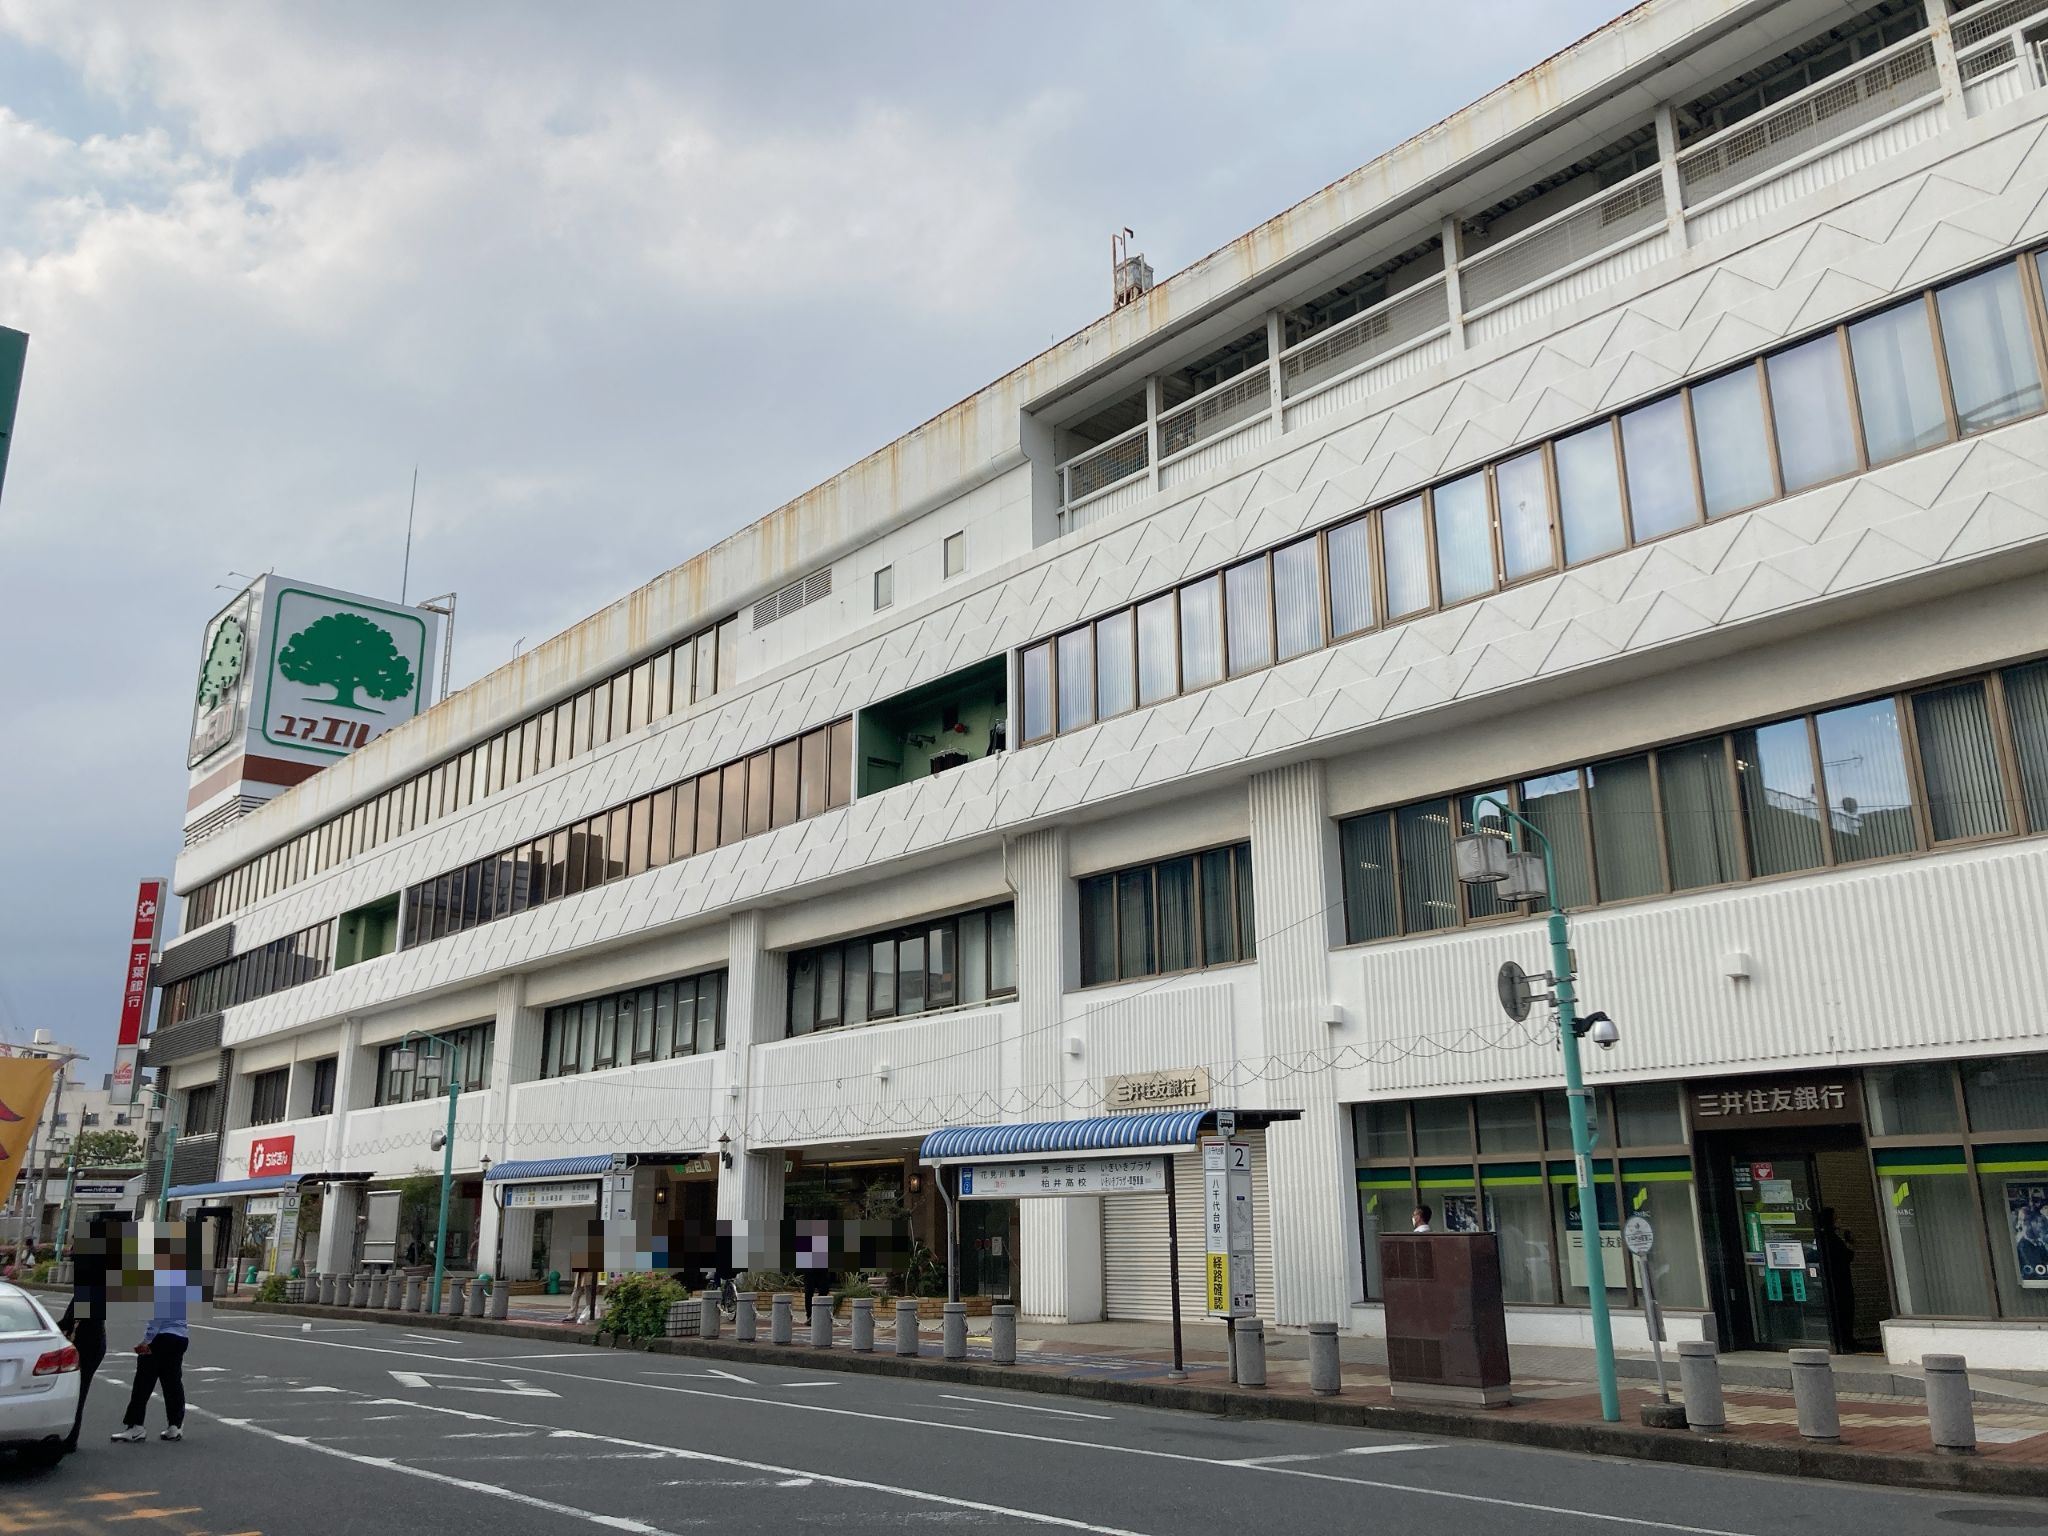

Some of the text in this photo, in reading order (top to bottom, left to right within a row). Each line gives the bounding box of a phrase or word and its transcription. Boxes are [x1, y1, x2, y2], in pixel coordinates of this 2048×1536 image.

[127, 952, 147, 1008] 千葉銀行
[1117, 1078, 1196, 1102] 三井住友銀行
[1698, 1084, 1845, 1116] 三井住友銀行
[1101, 1161, 1152, 1173] いきいきプラザ
[1234, 1147, 1244, 1167] 2
[1040, 1164, 1087, 1175] 第一街区
[620, 1177, 626, 1190] 1
[1040, 1178, 1087, 1189] 柏井高校
[1212, 1178, 1221, 1234] 八千代台駅
